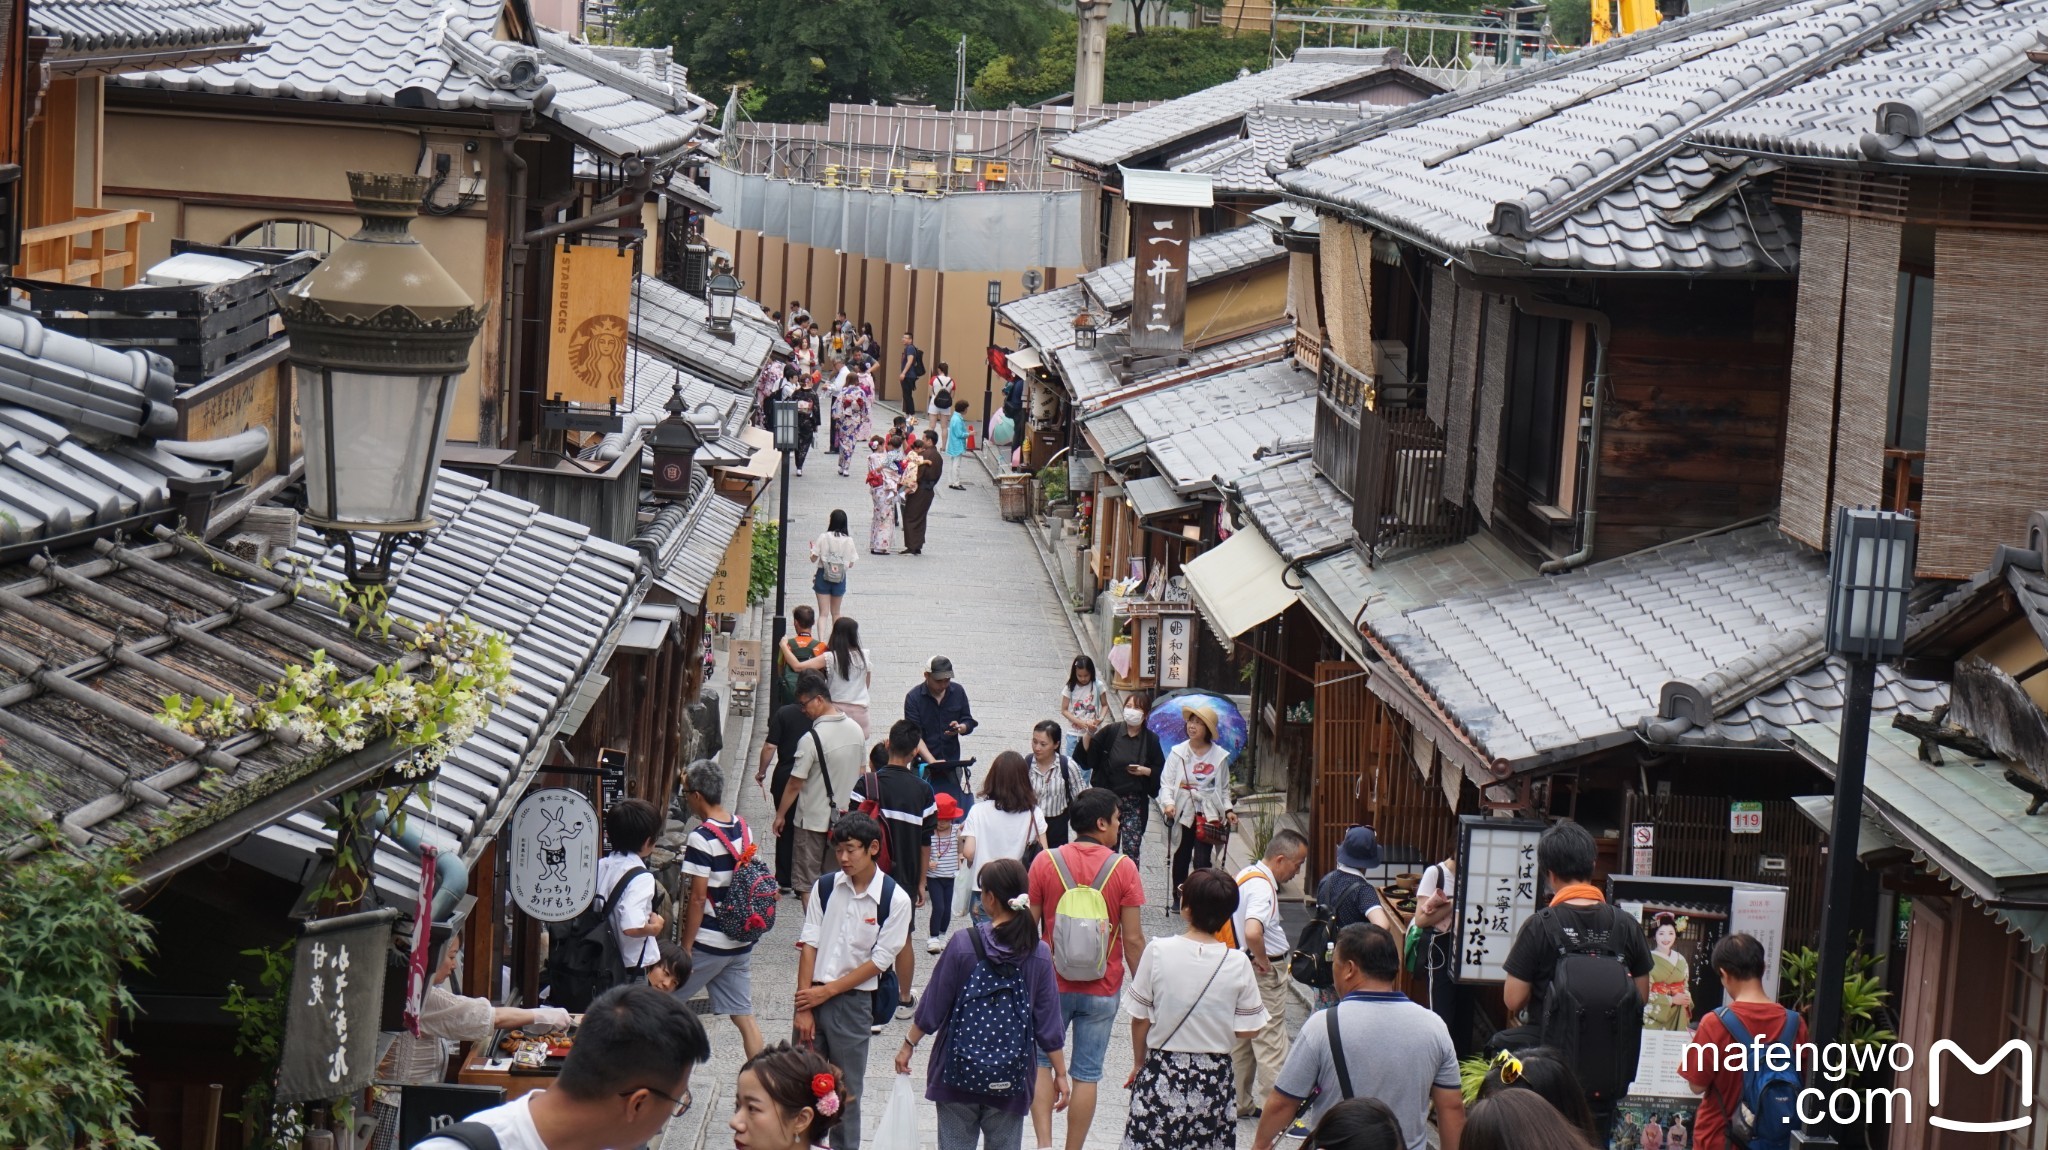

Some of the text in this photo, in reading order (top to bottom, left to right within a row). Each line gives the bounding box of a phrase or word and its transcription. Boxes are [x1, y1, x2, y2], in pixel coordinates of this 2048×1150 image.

[557, 256, 571, 334] STARBUCKS
[730, 668, 758, 677] Nagomi
[1167, 638, 1183, 681] 和傘屋
[1734, 813, 1760, 826] 119
[534, 882, 572, 896] もっちり
[1516, 843, 1535, 899] そば処
[530, 894, 574, 909] あげもち
[1492, 878, 1512, 933] 二寧坂
[1465, 904, 1489, 966] ふたば
